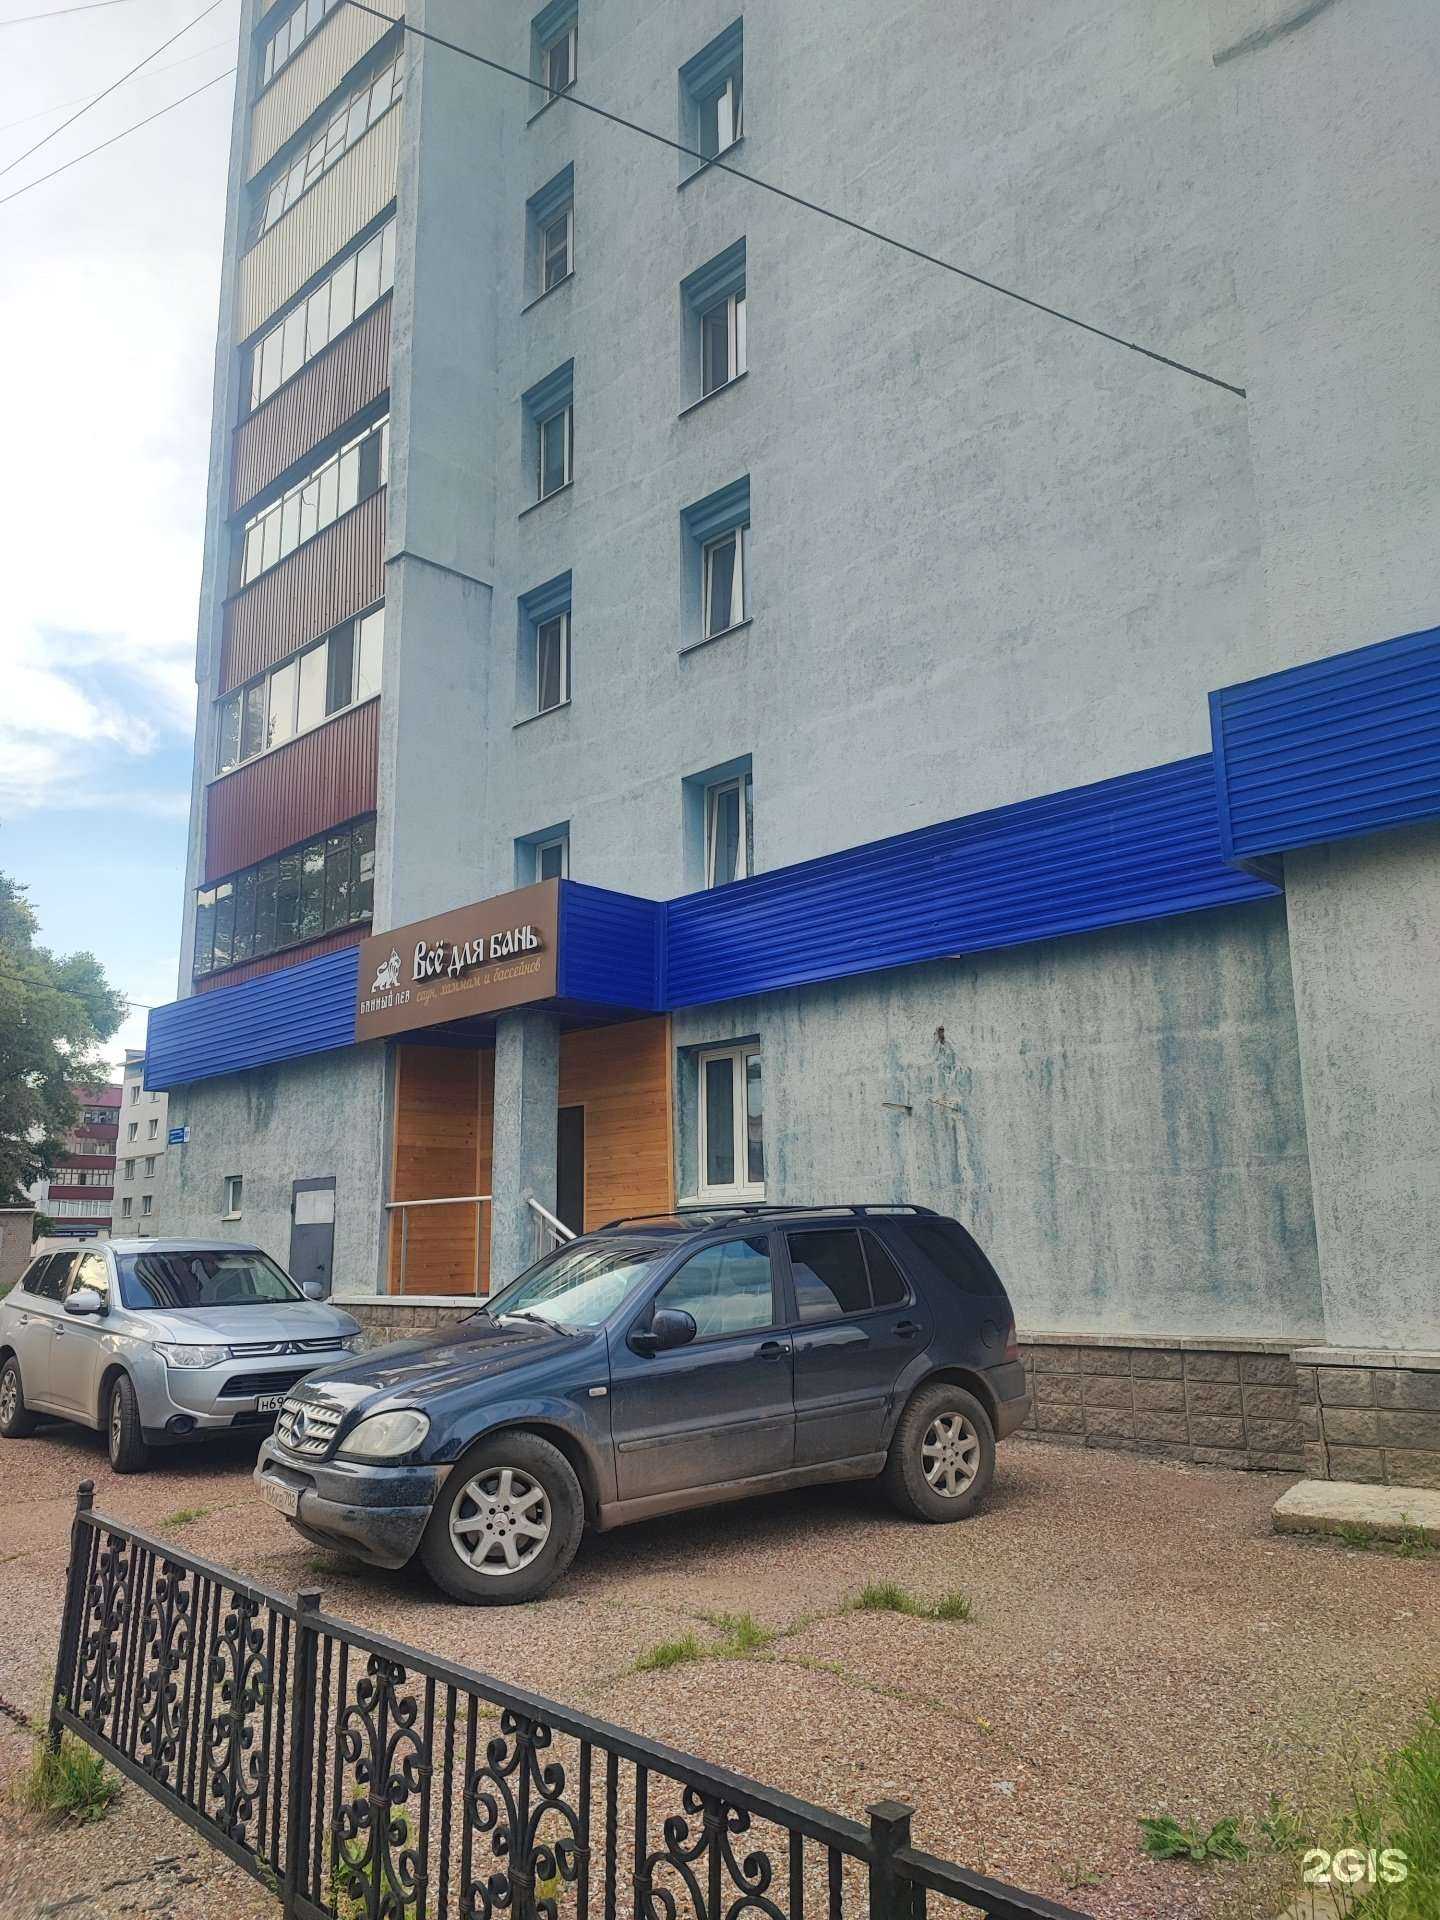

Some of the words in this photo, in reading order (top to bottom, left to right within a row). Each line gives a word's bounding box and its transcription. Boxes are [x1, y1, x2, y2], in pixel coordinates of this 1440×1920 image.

[489, 924, 538, 959] БАНЬ
[493, 956, 542, 983] бассейнов
[360, 990, 393, 1015] БАННЫЙ
[395, 990, 410, 1004] ЛЕВ
